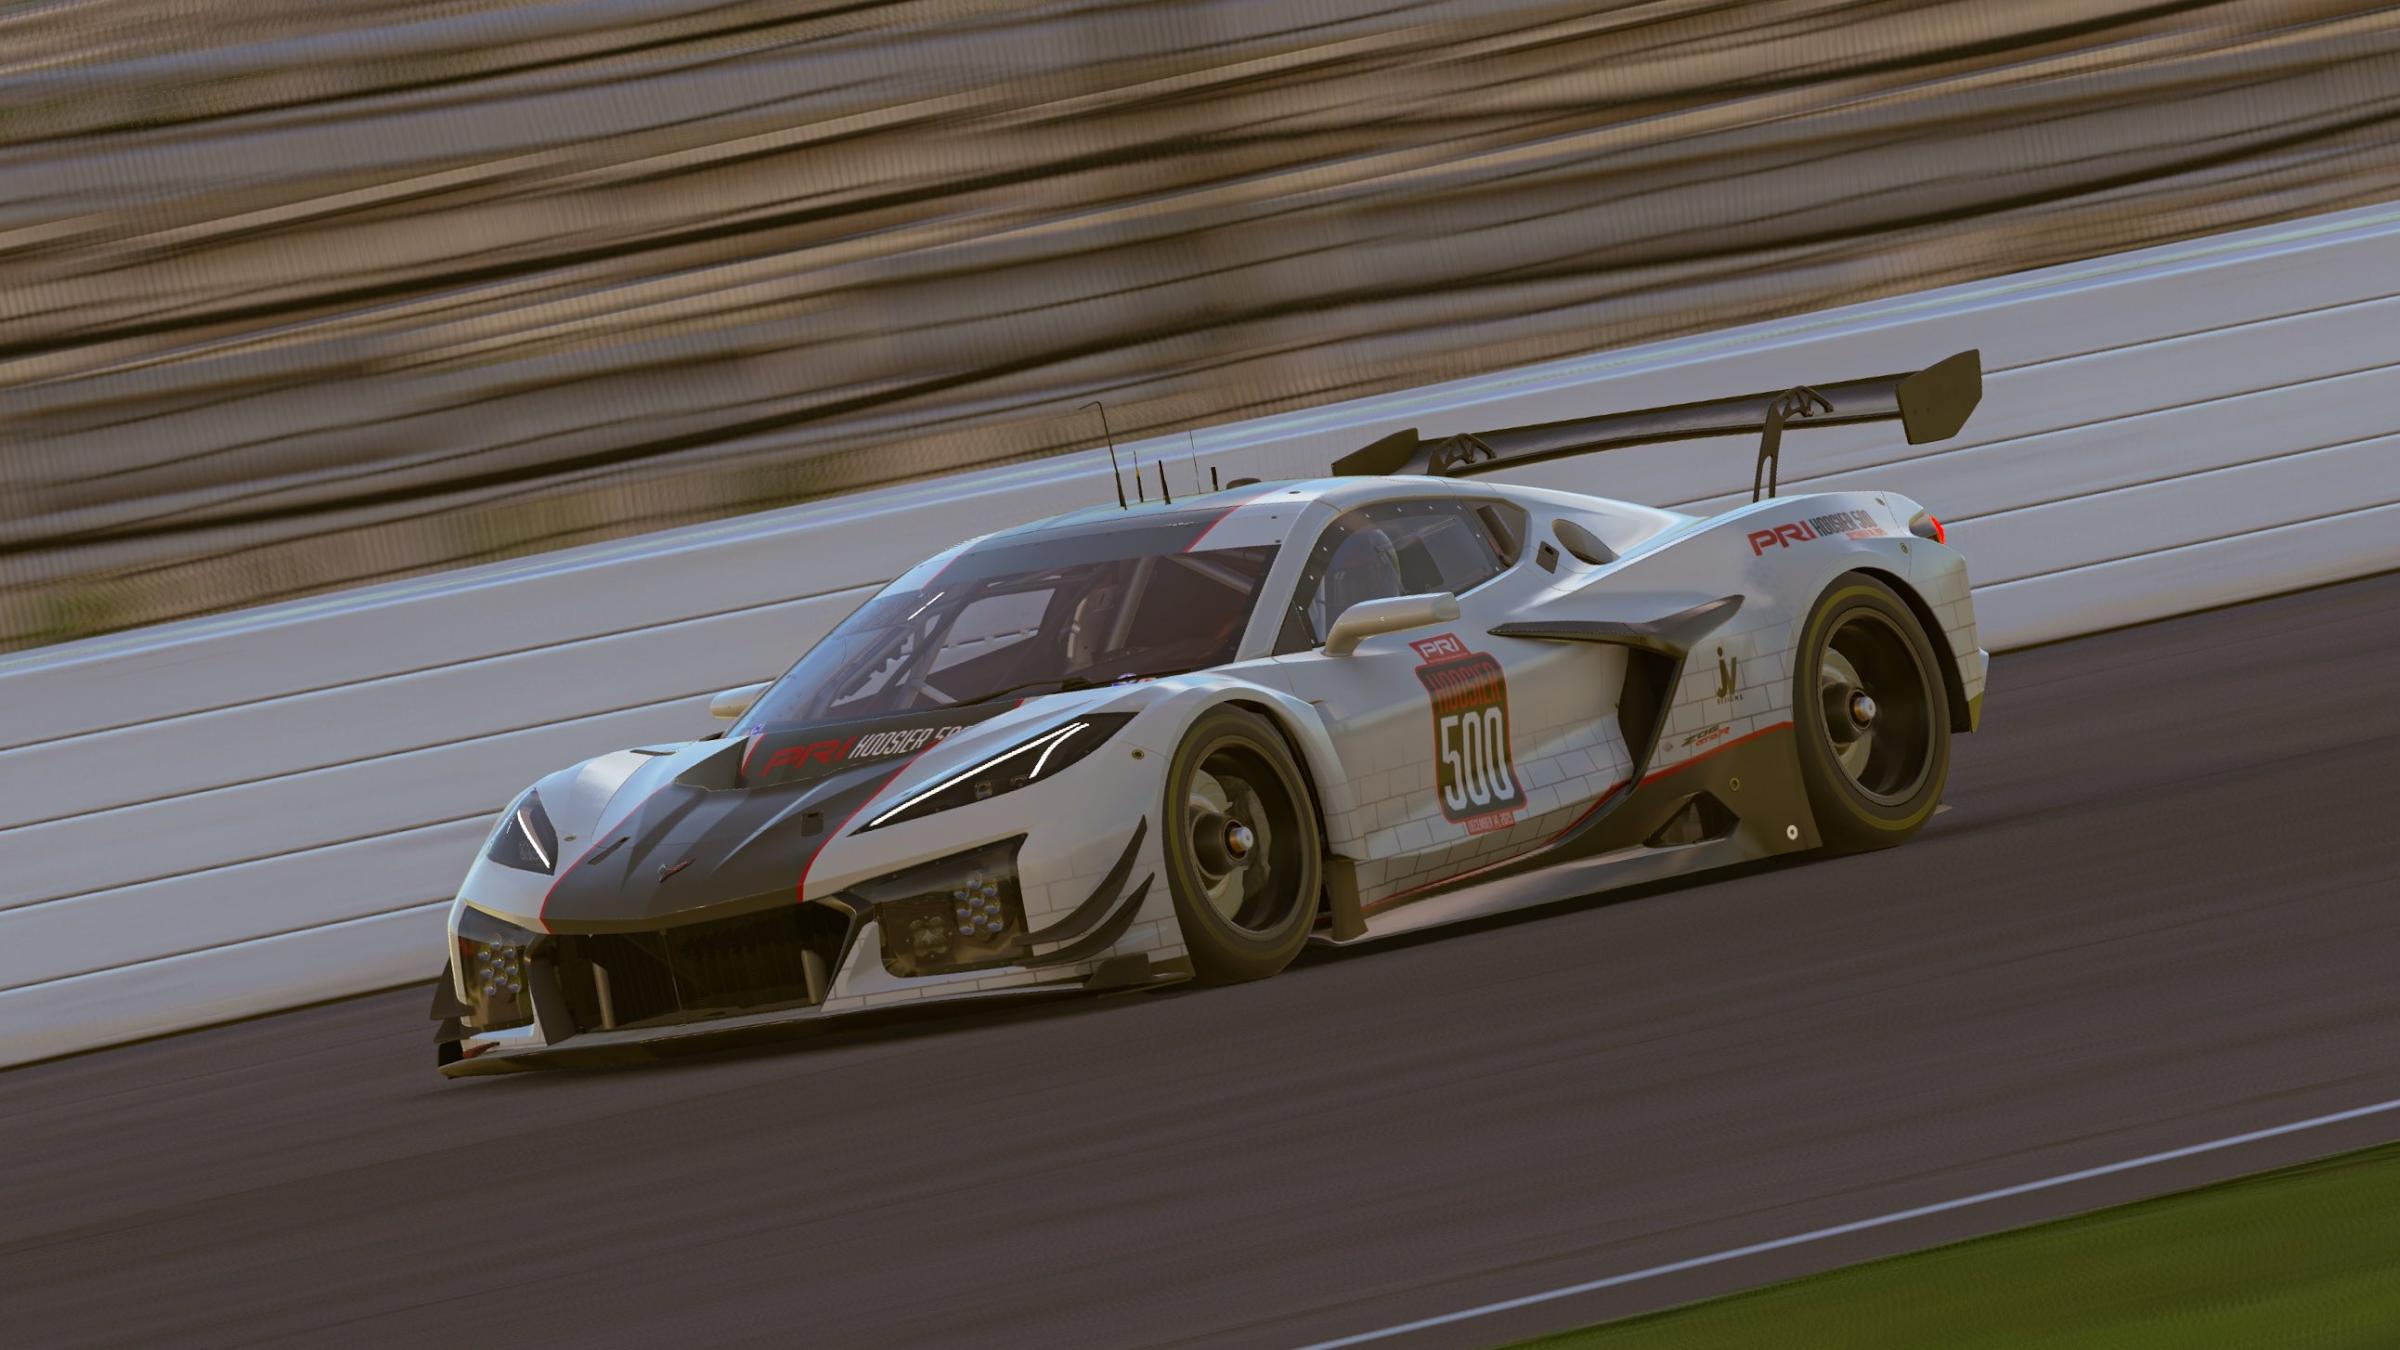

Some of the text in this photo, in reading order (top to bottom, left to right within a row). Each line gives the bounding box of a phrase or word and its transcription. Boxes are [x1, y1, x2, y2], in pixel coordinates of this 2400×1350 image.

[1747, 520, 1818, 556] PRI
[1808, 512, 1859, 537] HOOSIER
[1420, 637, 1460, 658] PRI
[1426, 661, 1500, 714] HOOSIER
[761, 725, 973, 777] PRI HOOSIER 50
[1440, 706, 1515, 811] 500
